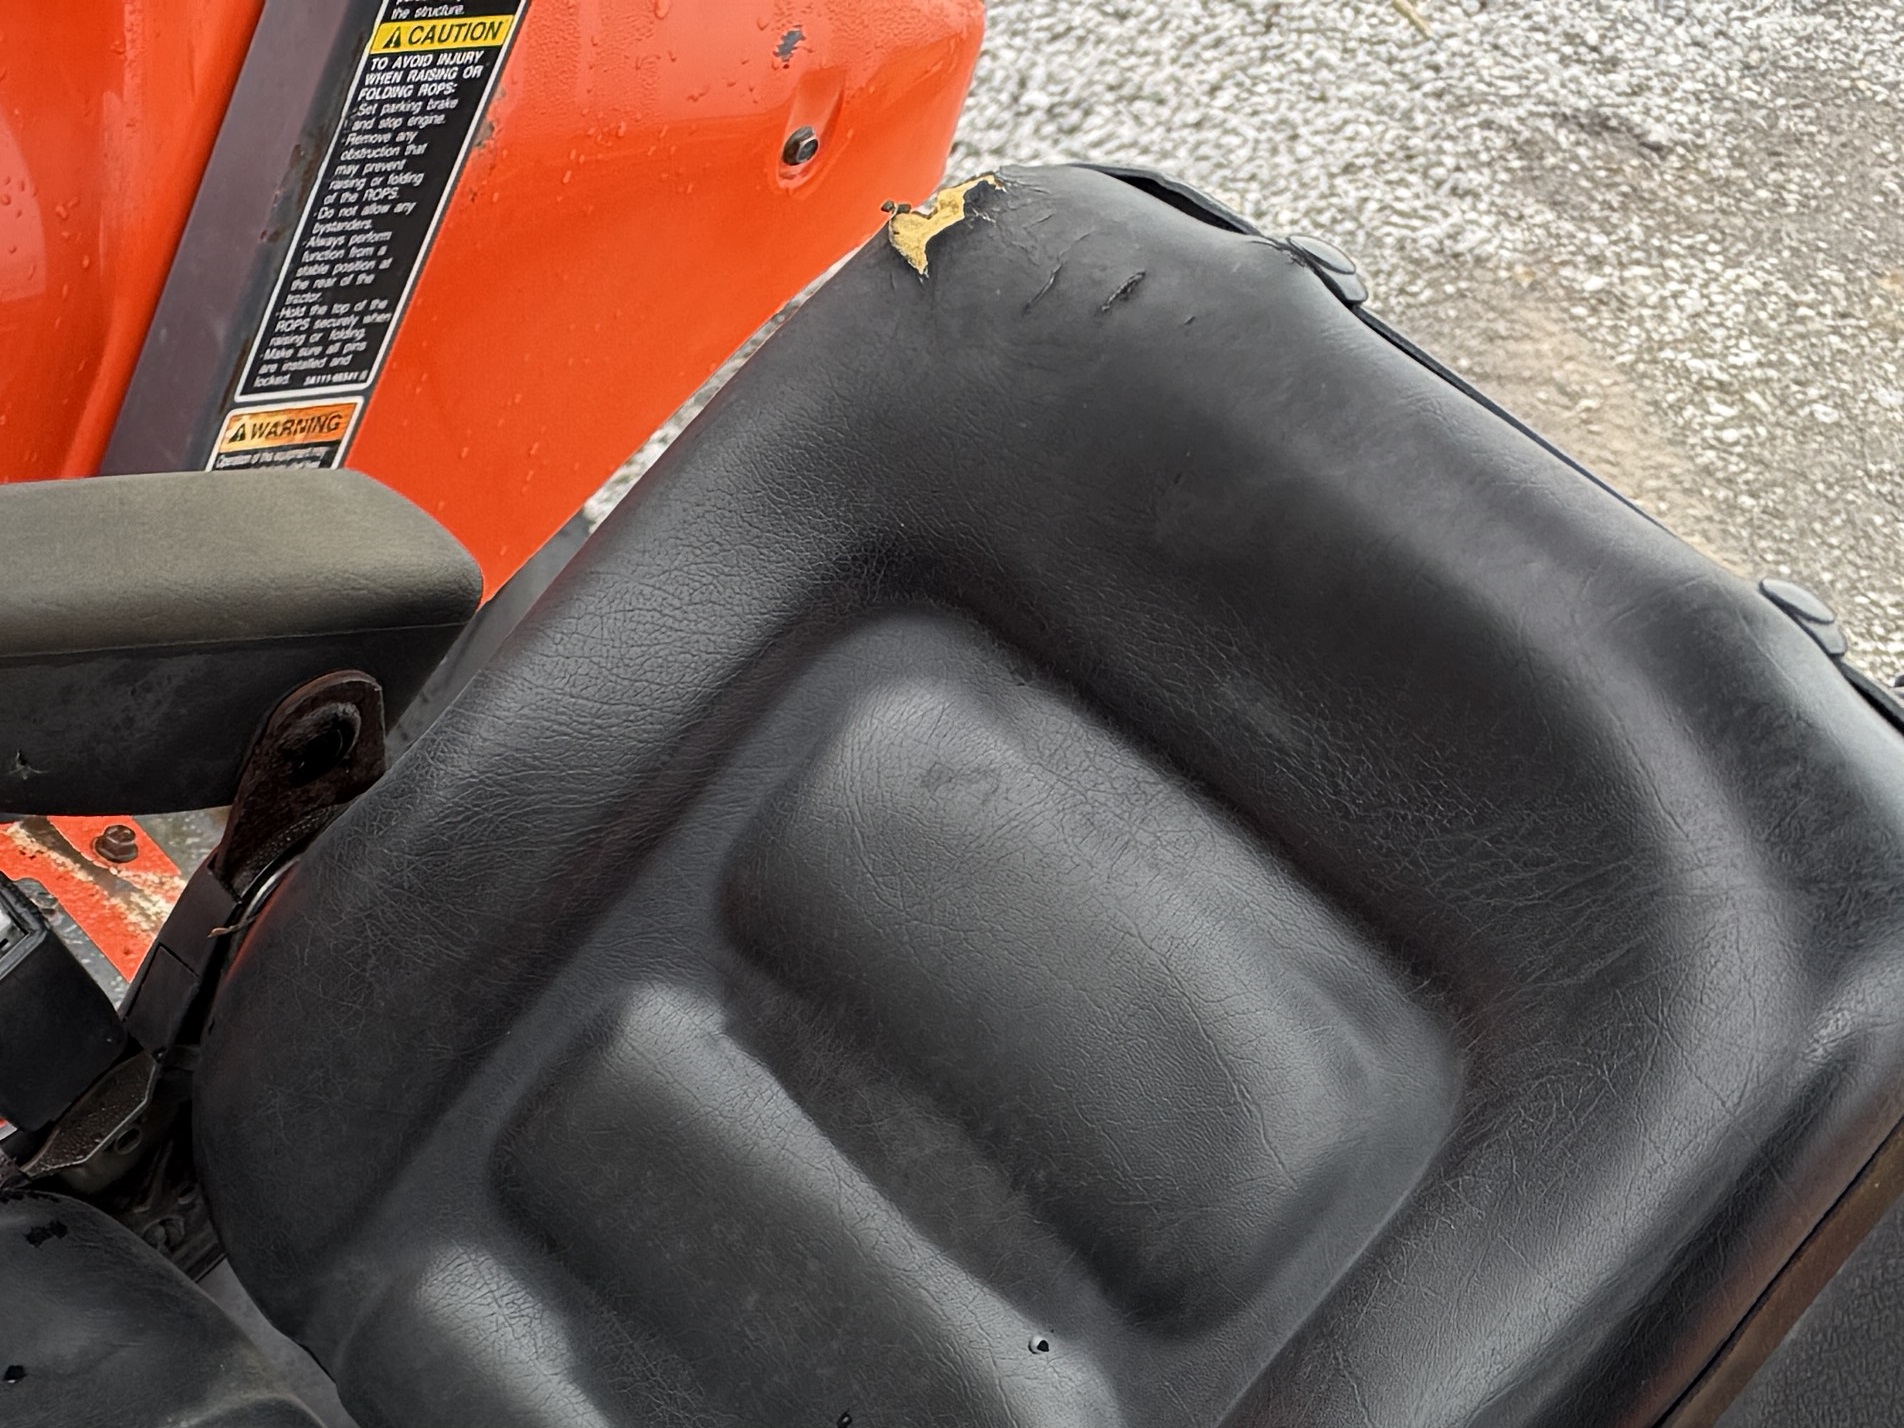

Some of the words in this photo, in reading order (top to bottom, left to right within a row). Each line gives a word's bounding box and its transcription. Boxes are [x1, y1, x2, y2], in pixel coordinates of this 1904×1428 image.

[408, 21, 503, 45] CAUTION
[368, 57, 389, 70] TO
[391, 54, 434, 68] AVOID
[436, 50, 484, 65] INJURY
[362, 72, 403, 85] WHEN
[405, 67, 459, 82] RAISING
[460, 65, 484, 78] OR
[356, 84, 415, 101] FOLDING
[417, 81, 459, 96] ROPS:
[249, 414, 343, 440] WARNING
